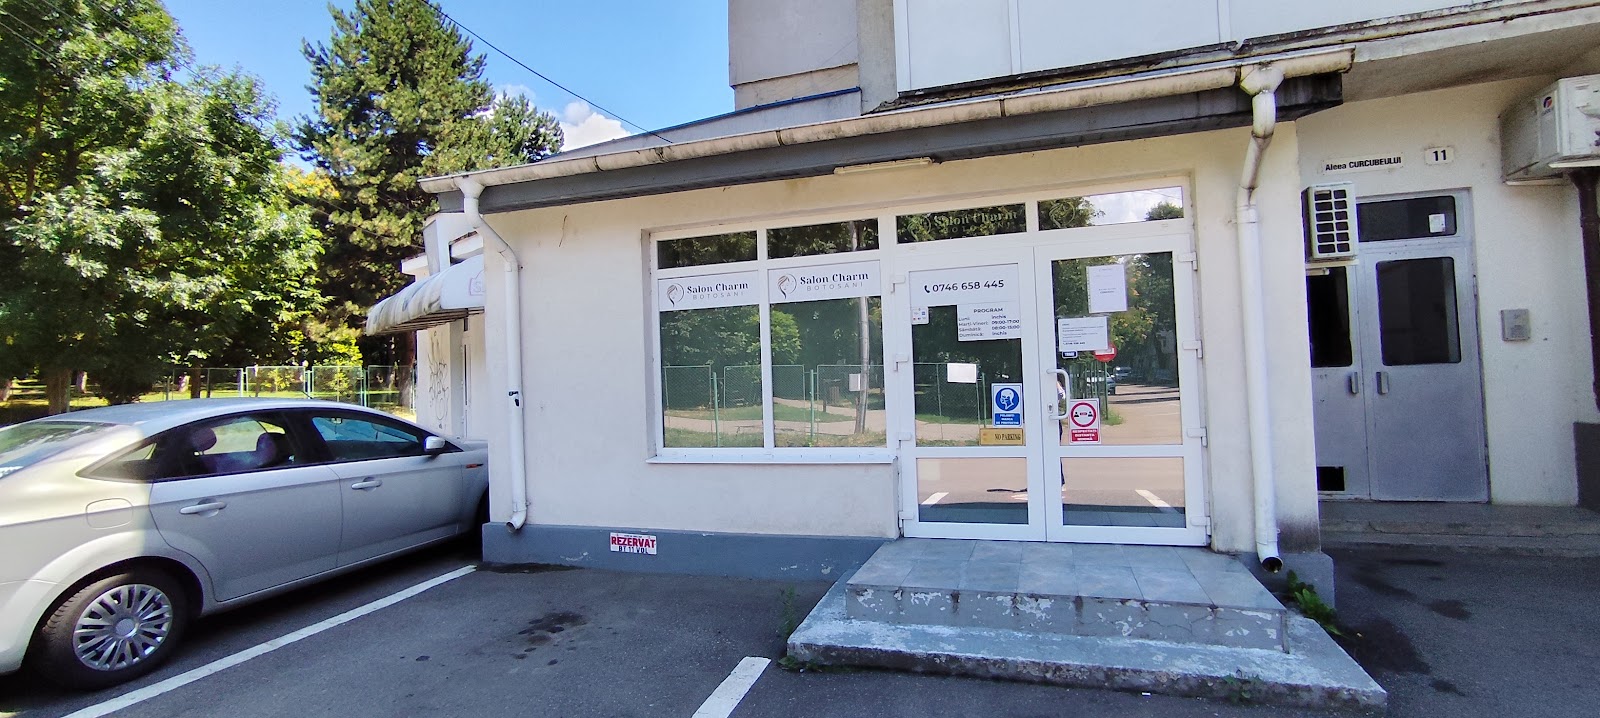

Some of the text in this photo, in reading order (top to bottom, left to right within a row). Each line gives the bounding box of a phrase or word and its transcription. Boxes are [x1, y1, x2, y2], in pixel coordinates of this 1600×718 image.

[1433, 149, 1447, 161] 11
[1325, 156, 1402, 171] Aleea CURCUBEULUI
[800, 272, 869, 285] Salon Charm
[686, 281, 749, 294] Salon Charm
[806, 282, 864, 291] BOTOSANI
[932, 279, 1004, 292] 0746 658 445
[693, 290, 744, 300] BOTOSANI
[994, 433, 1021, 441] NO PARKING
[611, 536, 655, 548] REZERVAT
